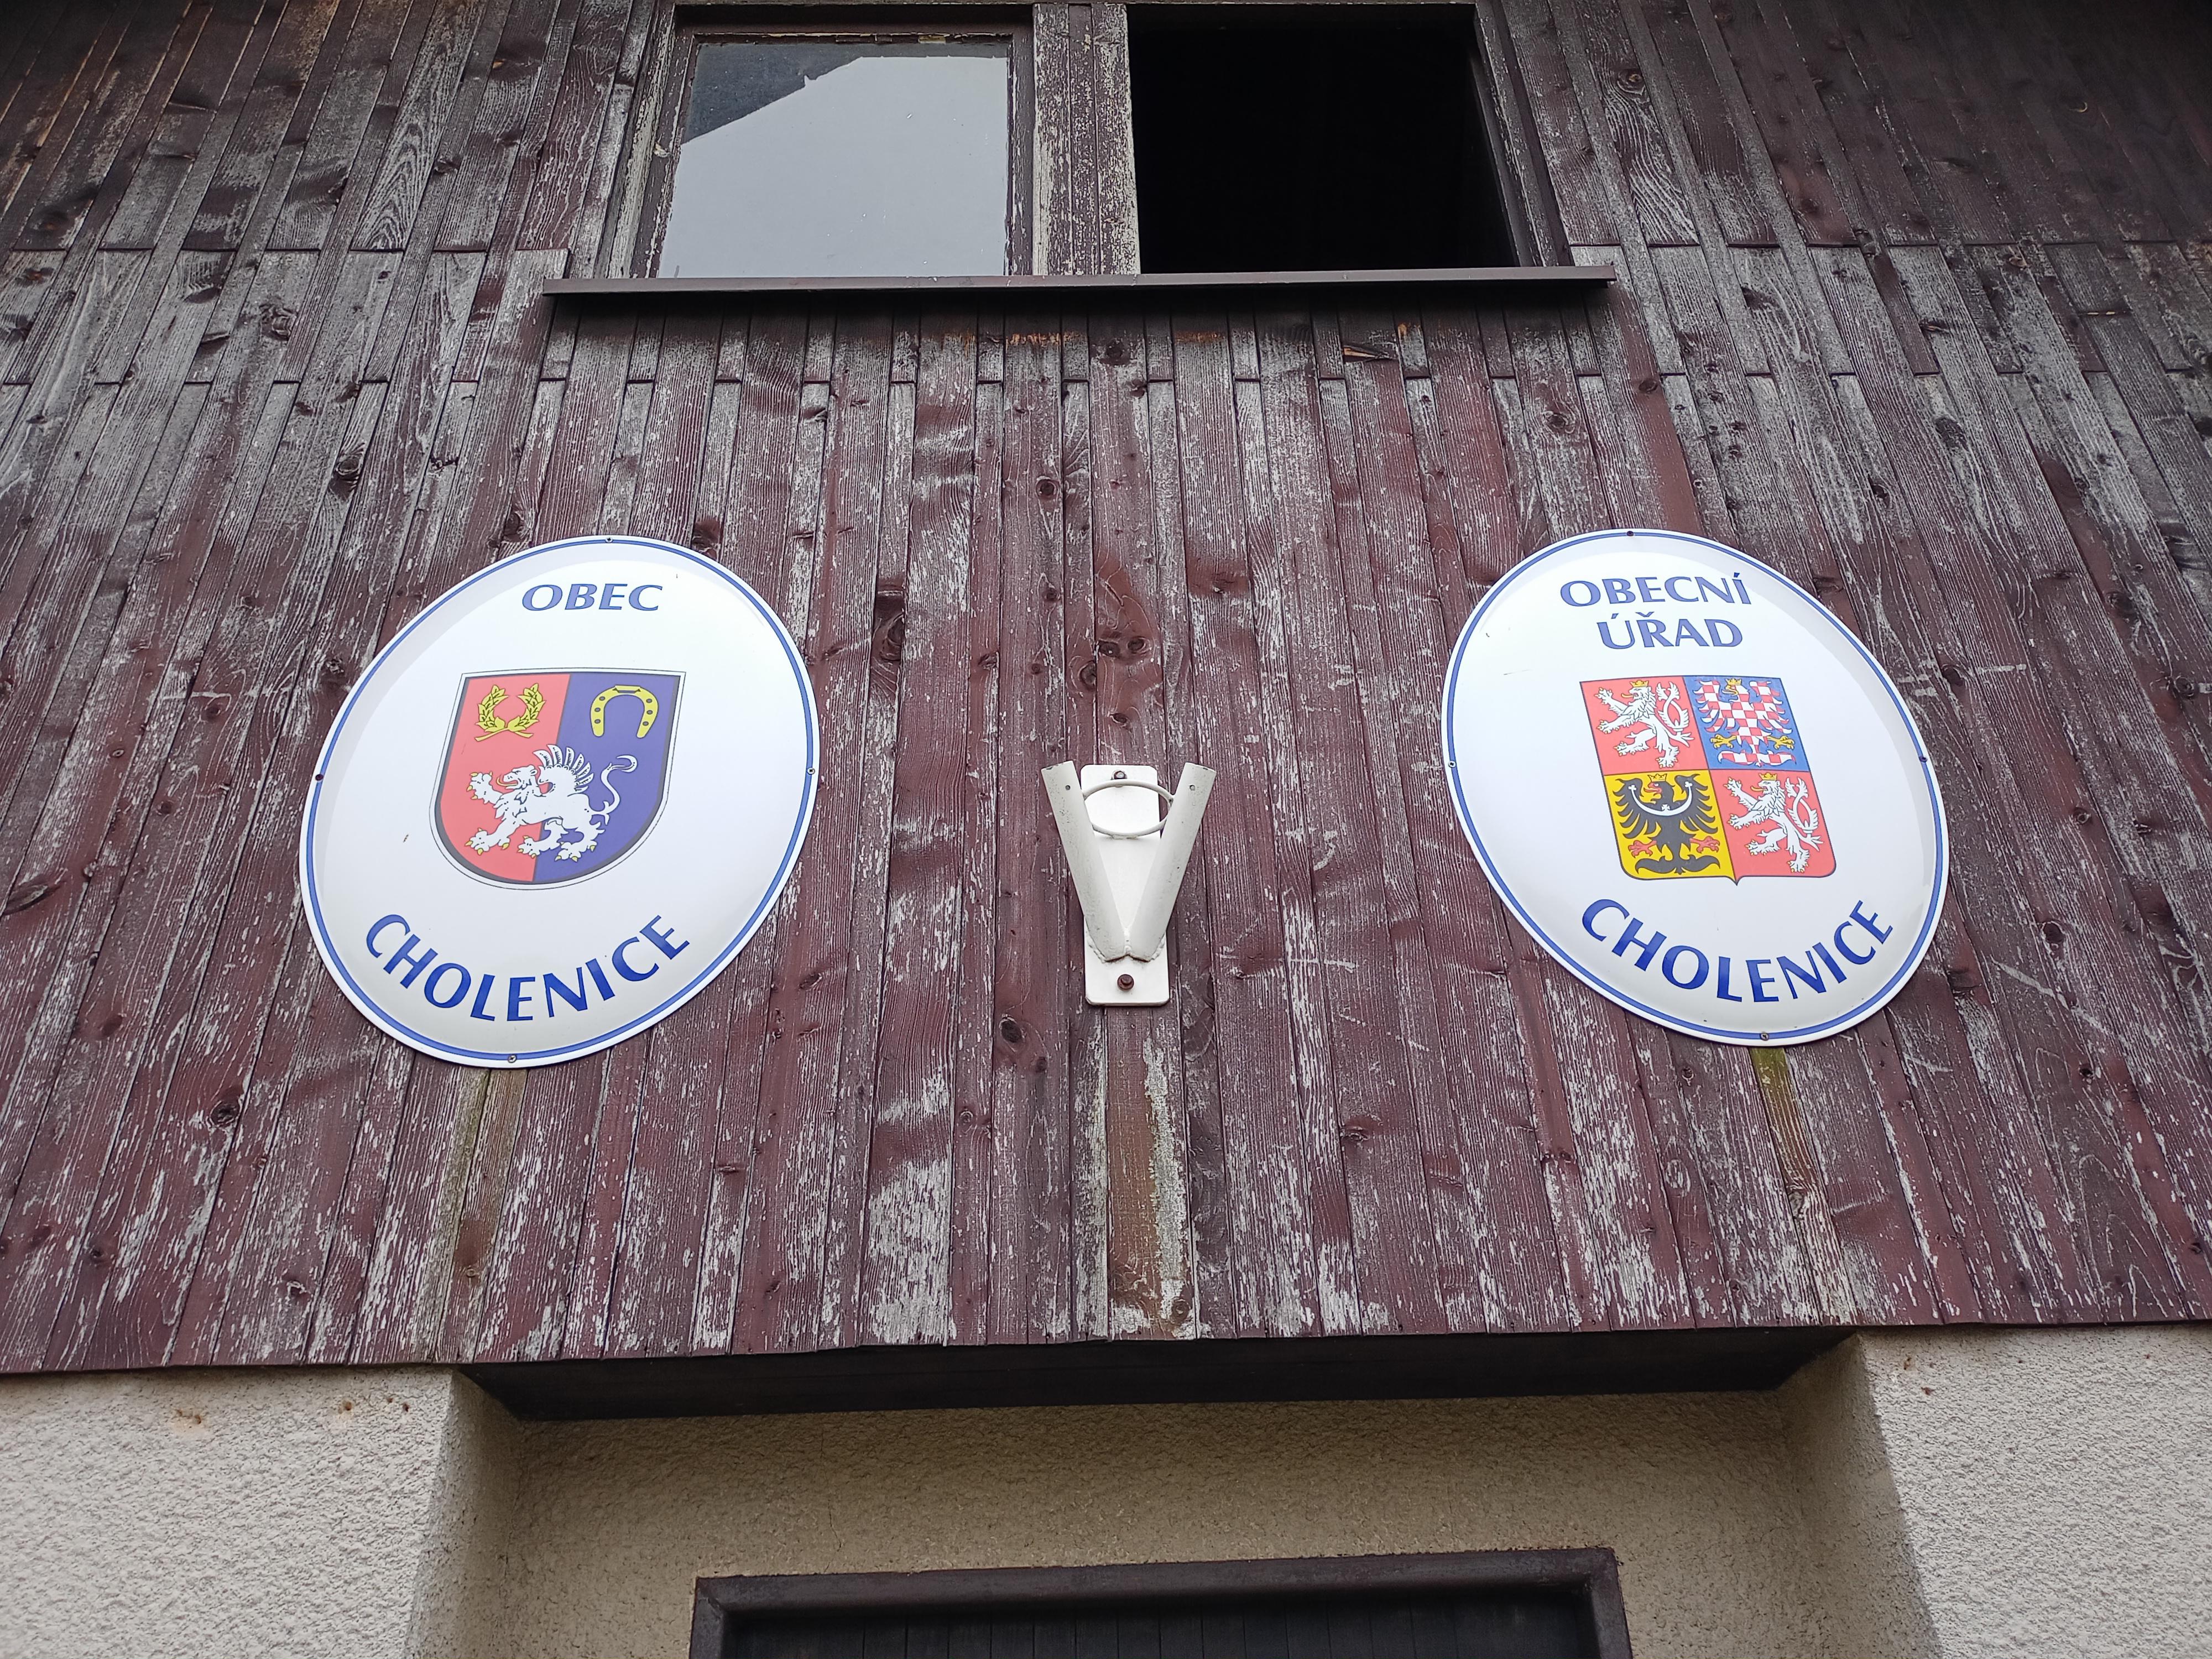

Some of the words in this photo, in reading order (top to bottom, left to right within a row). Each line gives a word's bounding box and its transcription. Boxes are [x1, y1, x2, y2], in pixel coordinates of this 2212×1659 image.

[521, 583, 663, 611] OBEC
[1560, 572, 1752, 607] OBECNÍ
[1597, 612, 1743, 650] ÚŘAD
[366, 914, 690, 1022] CHOLENICE
[1582, 899, 1893, 1003] CHOLENICE
